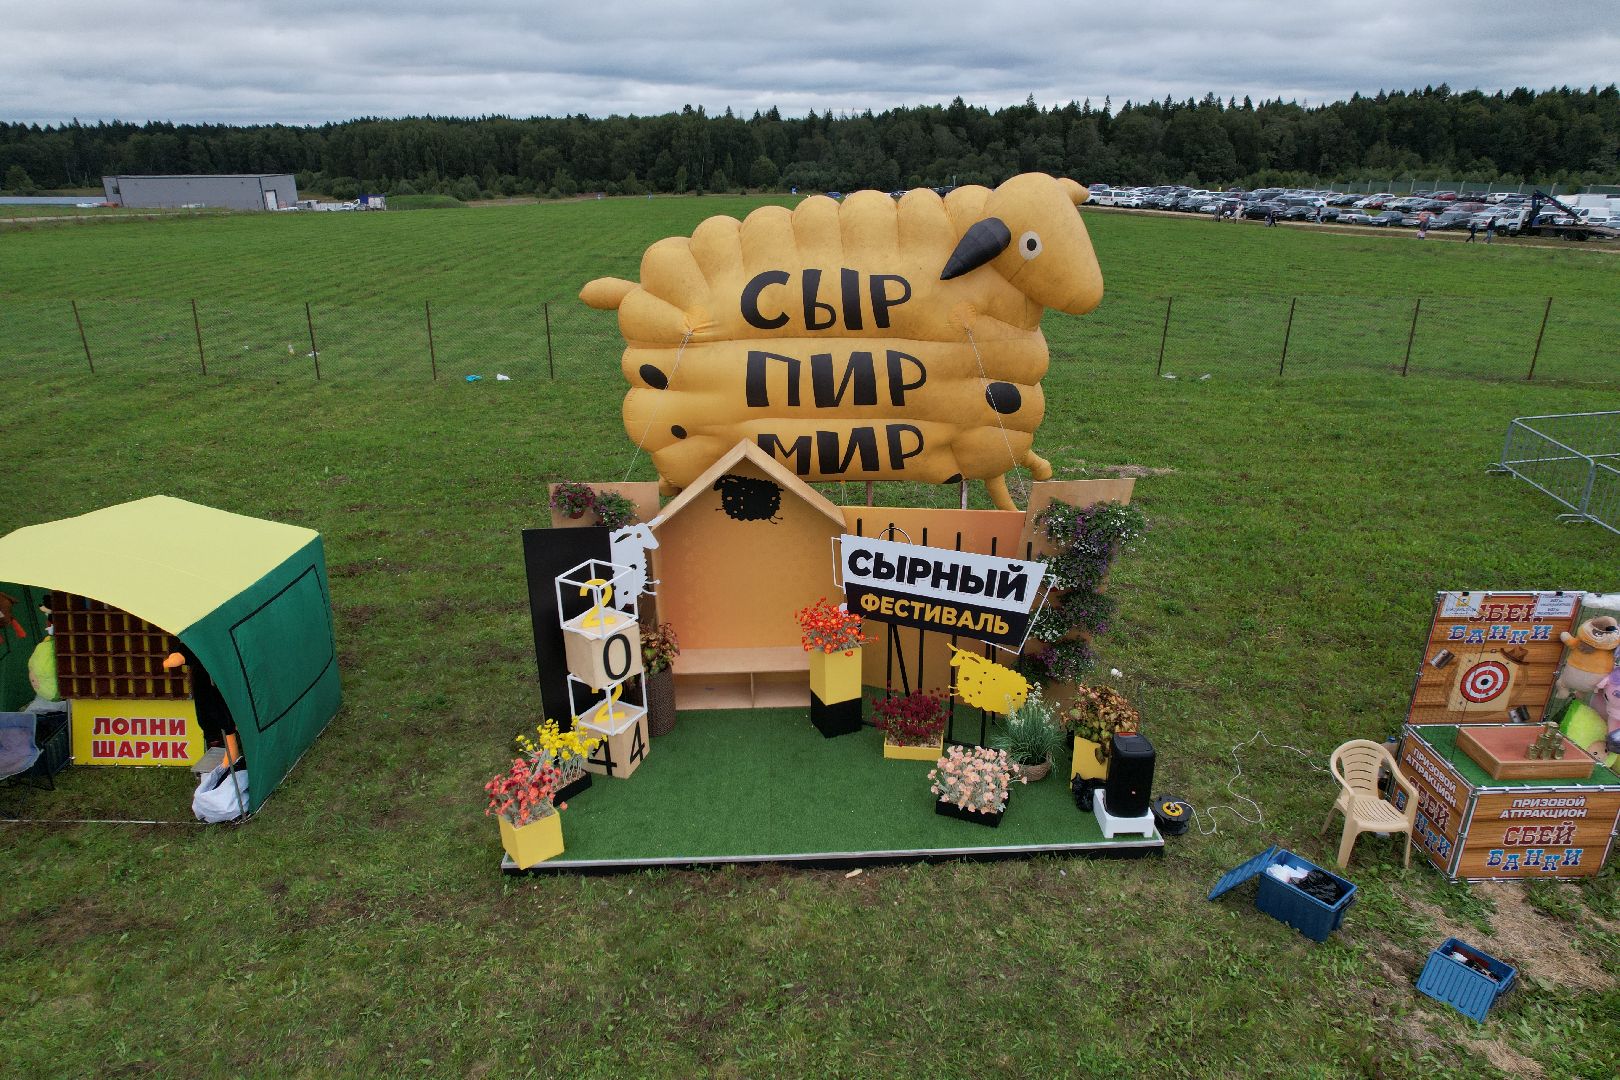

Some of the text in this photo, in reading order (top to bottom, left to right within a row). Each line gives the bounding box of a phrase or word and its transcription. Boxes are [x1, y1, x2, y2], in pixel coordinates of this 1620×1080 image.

[740, 268, 912, 331] СЫР
[745, 350, 927, 408] ПИР
[757, 423, 924, 476] МИР
[847, 548, 1029, 603] СЫРНЫЙ
[860, 592, 1010, 636] ФЕСТИВАЛЬ
[1448, 625, 1553, 645] БАНКИ
[93, 717, 186, 736] ЛОПНИ
[92, 740, 189, 760] ШАРИК
[1405, 753, 1457, 808] АТТРАКЦИОН
[1412, 747, 1457, 794] ПРИЗОВОЙ
[1499, 808, 1588, 819] АТТРАКЦИОН
[1512, 795, 1586, 808] ПРИЗОВОЙ
[1502, 821, 1576, 846] СБЕЙ
[1486, 848, 1584, 871] БАНКИ
